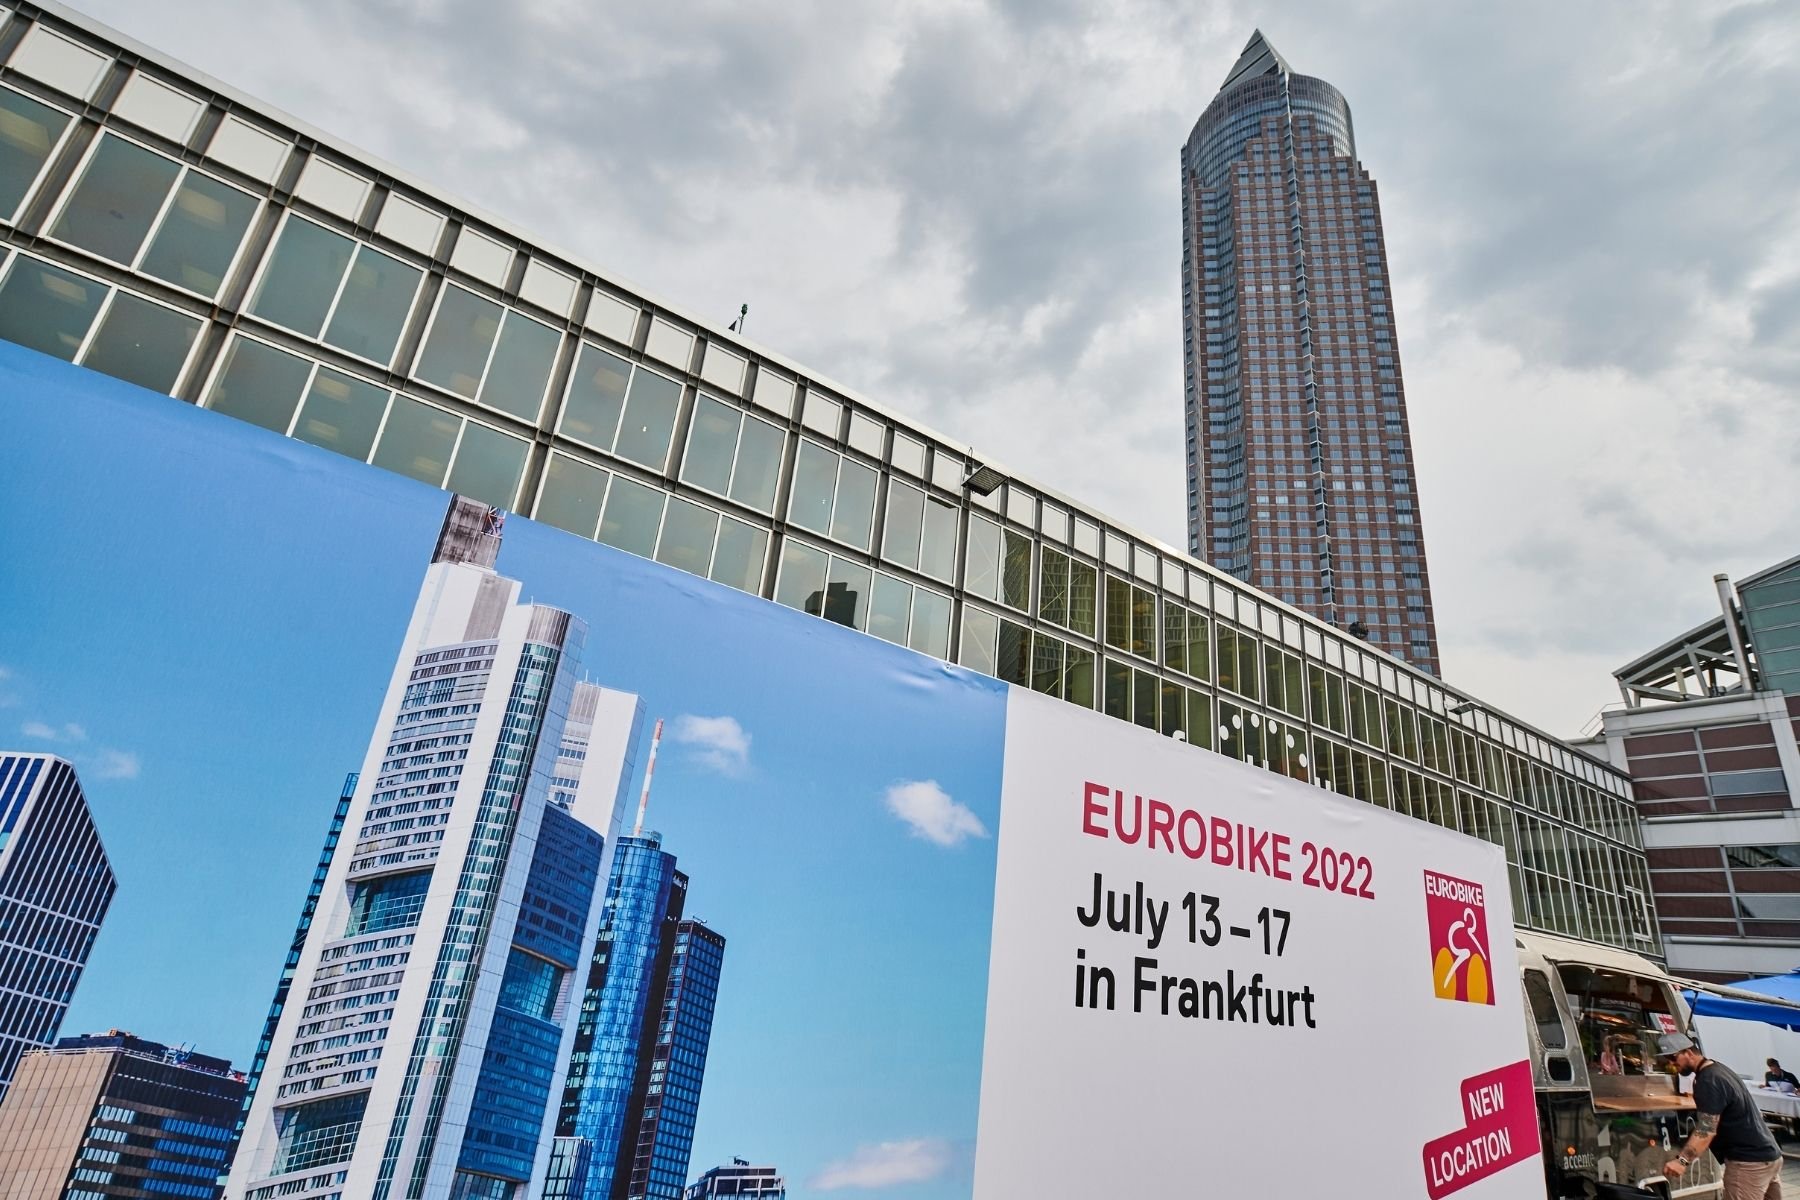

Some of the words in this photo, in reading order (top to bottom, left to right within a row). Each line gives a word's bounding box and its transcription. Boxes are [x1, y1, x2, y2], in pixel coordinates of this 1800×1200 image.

[1083, 782, 1292, 881] EUROBIKE
[1301, 841, 1375, 899] 2022
[1077, 873, 1169, 949] July
[1425, 874, 1484, 907] EUROBIKE
[1075, 949, 1116, 1011] in
[1133, 956, 1316, 1029] Frankfurt
[1468, 1082, 1504, 1120] NEW
[1430, 1126, 1512, 1187] LOCATION
